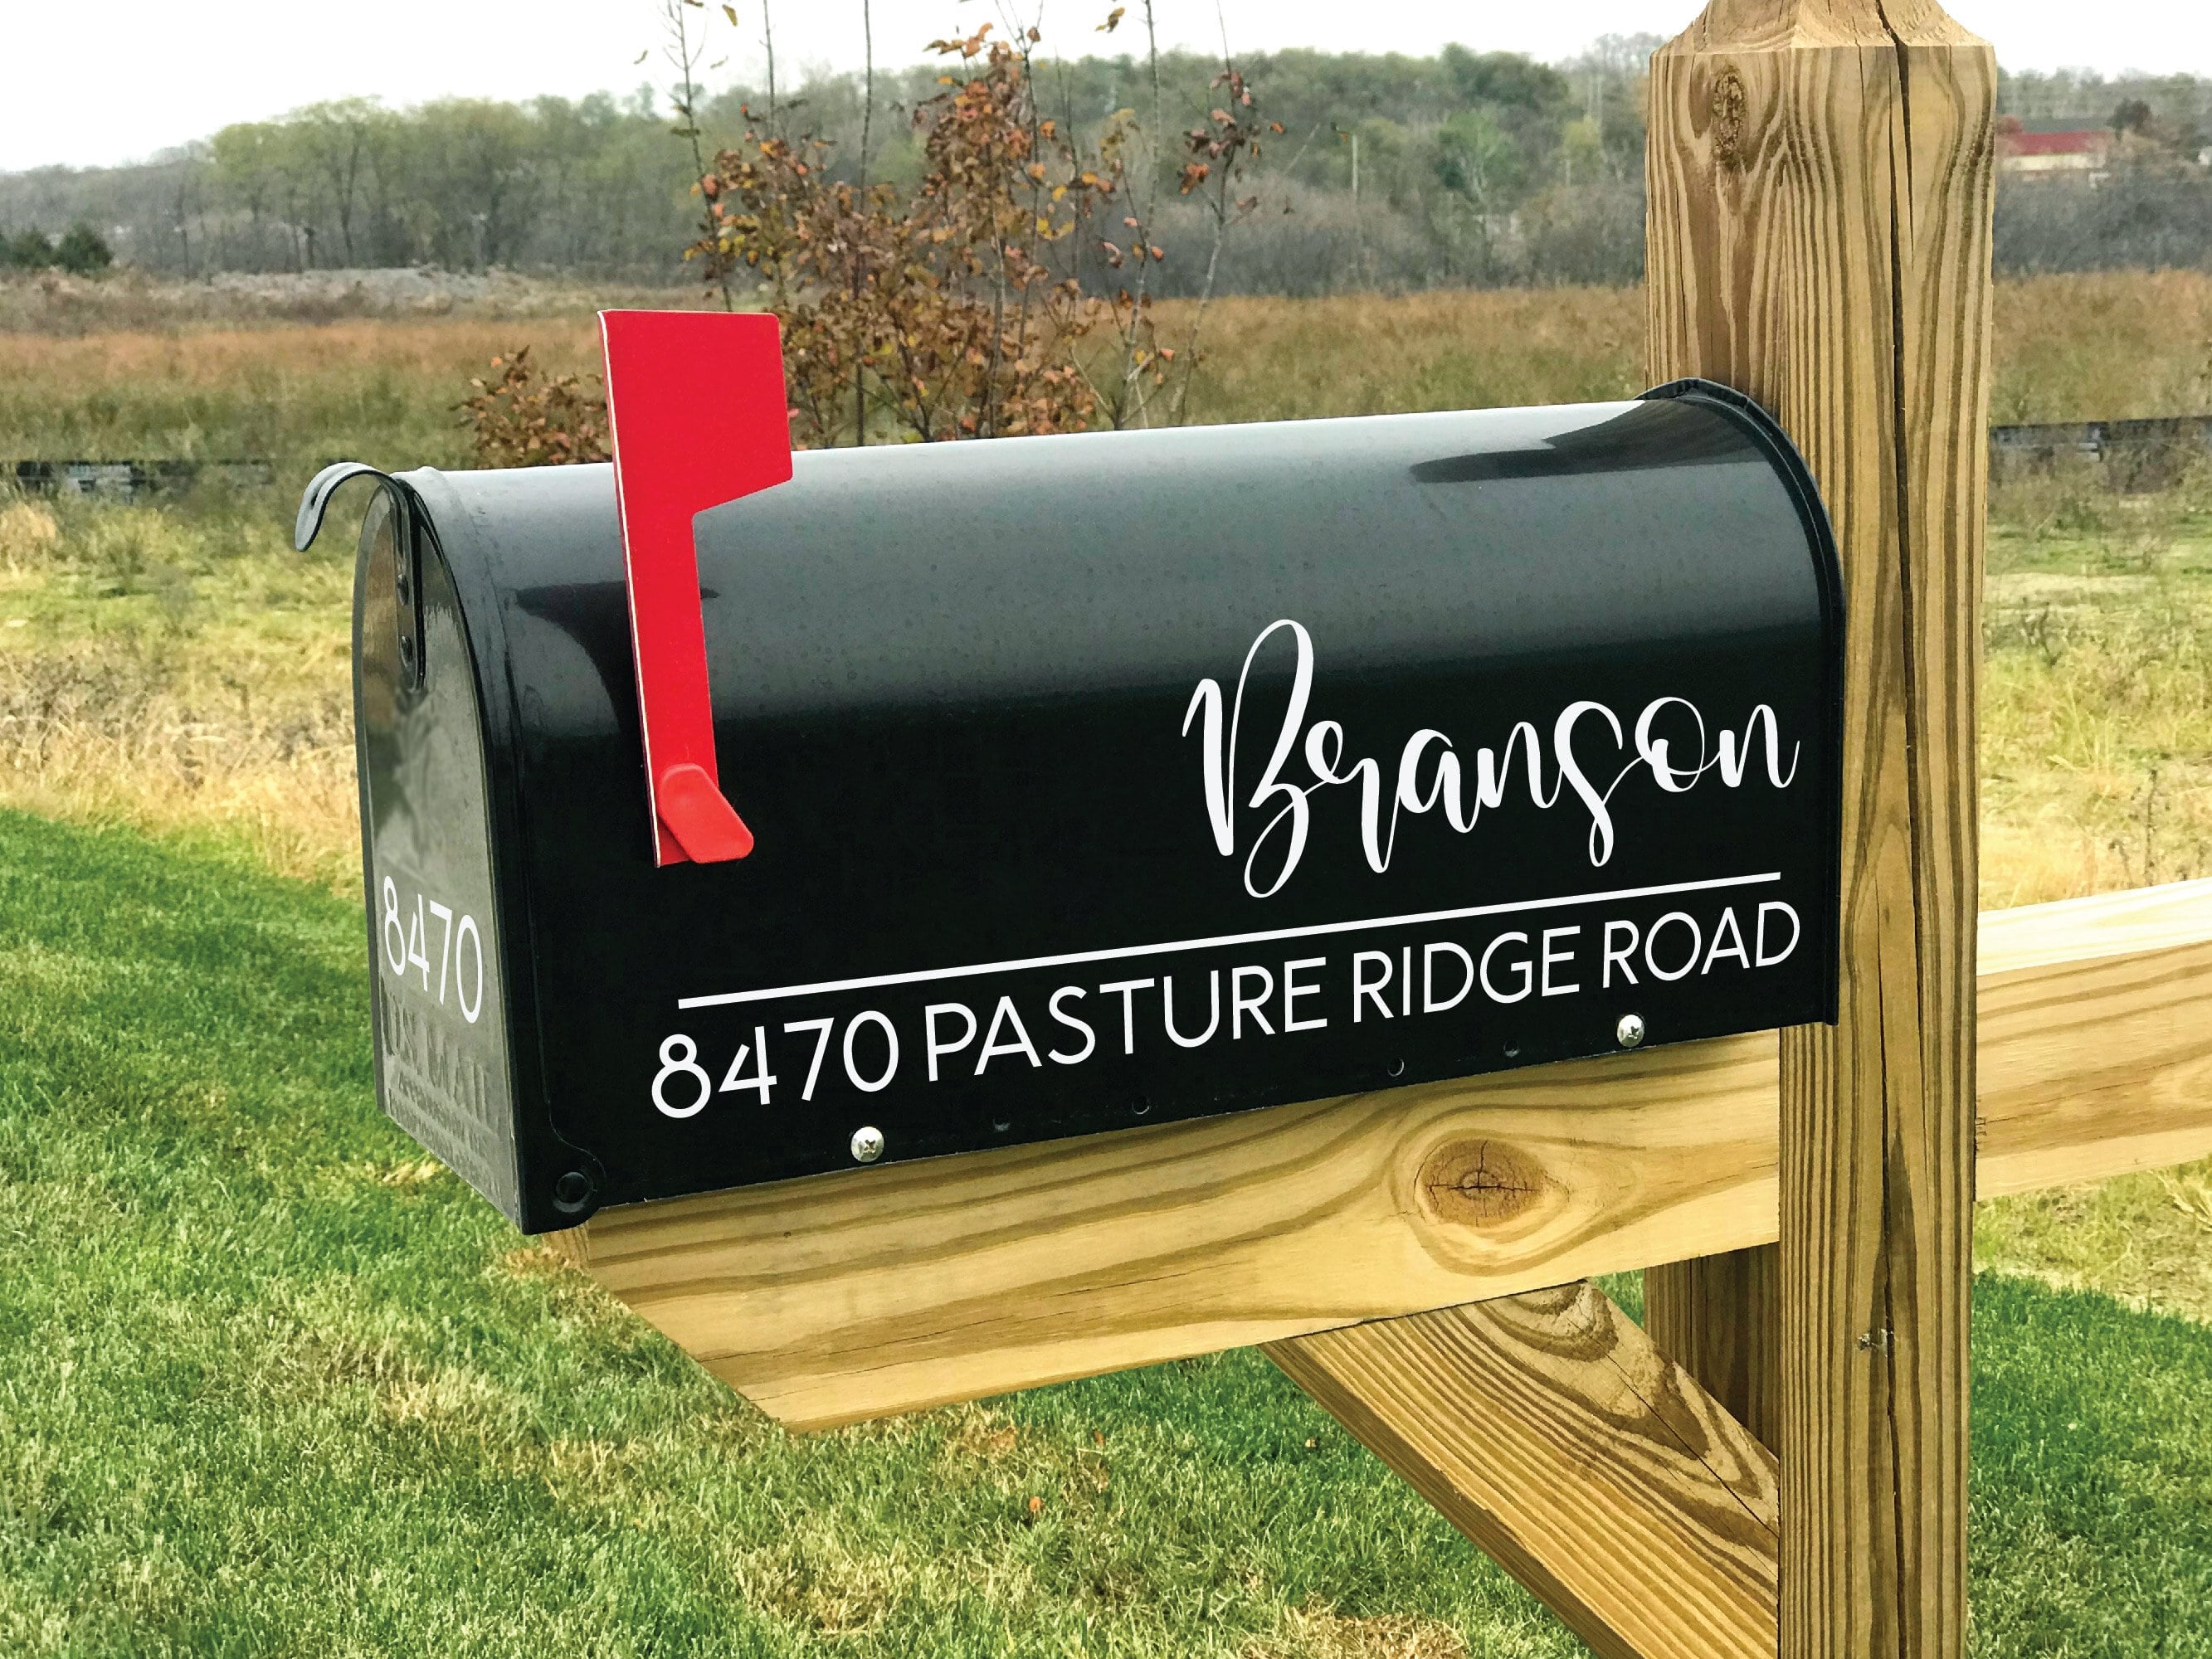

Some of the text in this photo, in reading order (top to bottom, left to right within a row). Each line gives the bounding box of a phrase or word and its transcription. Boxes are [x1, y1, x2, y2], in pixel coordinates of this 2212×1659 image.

[1182, 620, 1800, 898] Branson
[383, 875, 483, 1024] 8470
[652, 902, 1800, 1118] 8470 PASTURE RIDGE ROAD
